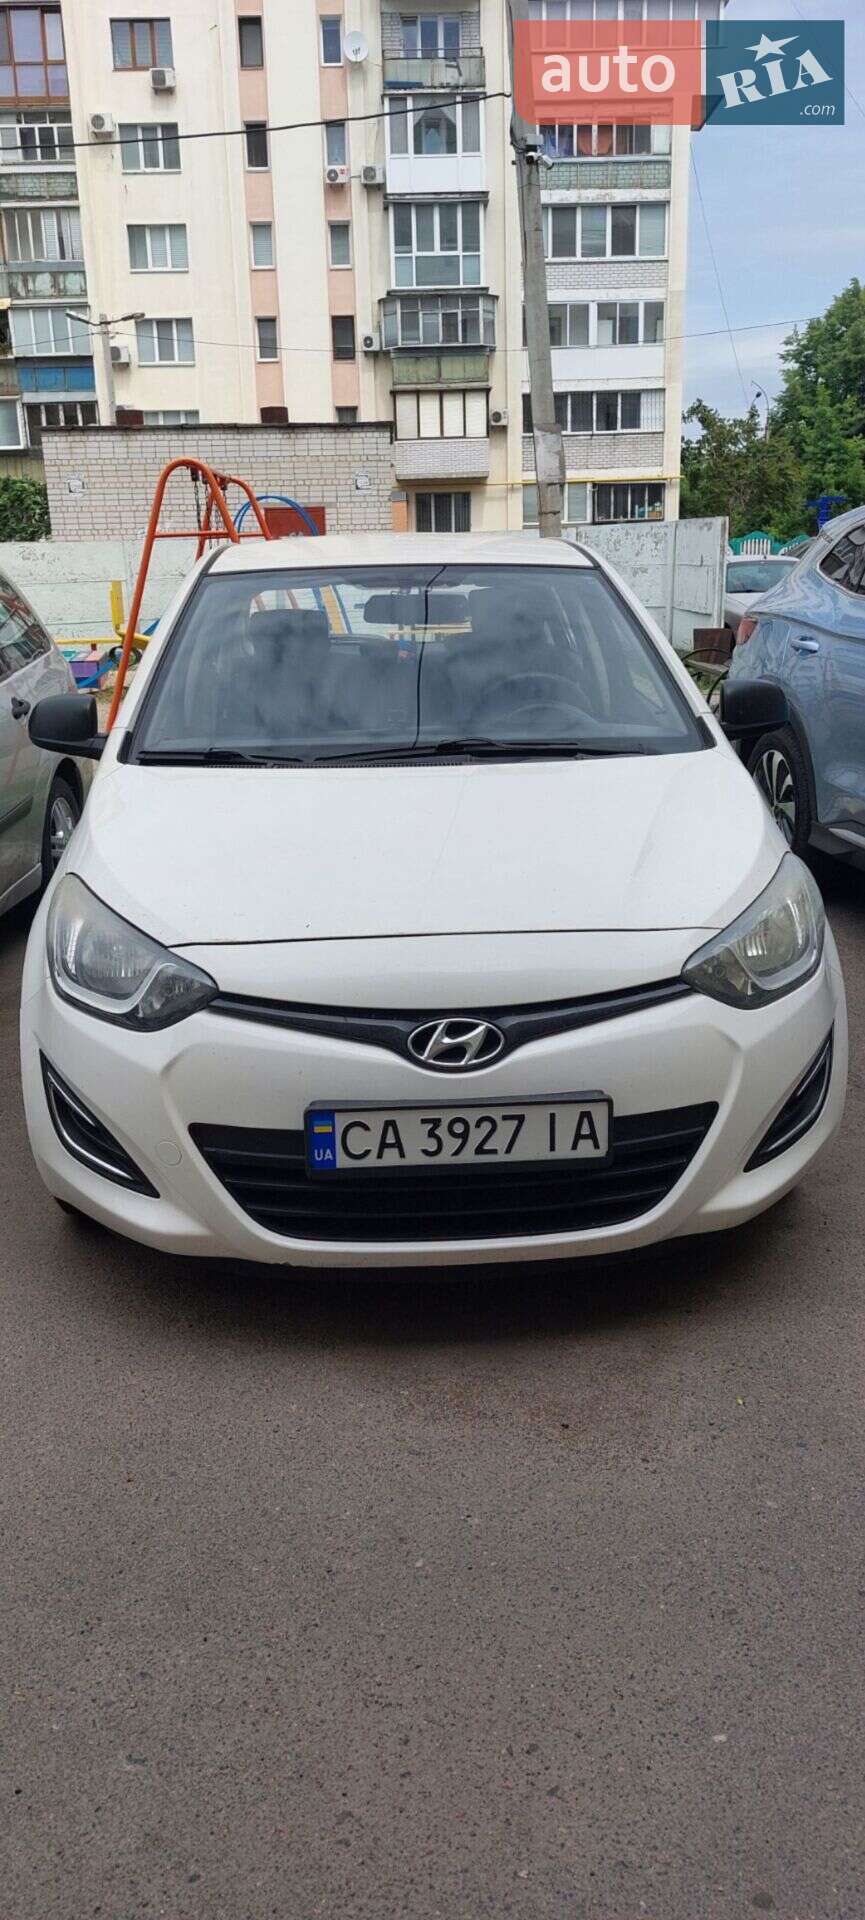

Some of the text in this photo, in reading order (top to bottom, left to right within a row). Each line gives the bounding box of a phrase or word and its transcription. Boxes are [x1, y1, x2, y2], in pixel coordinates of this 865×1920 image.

[340, 1110, 600, 1160] CA 3927 IA
[313, 1148, 333, 1161] UA
